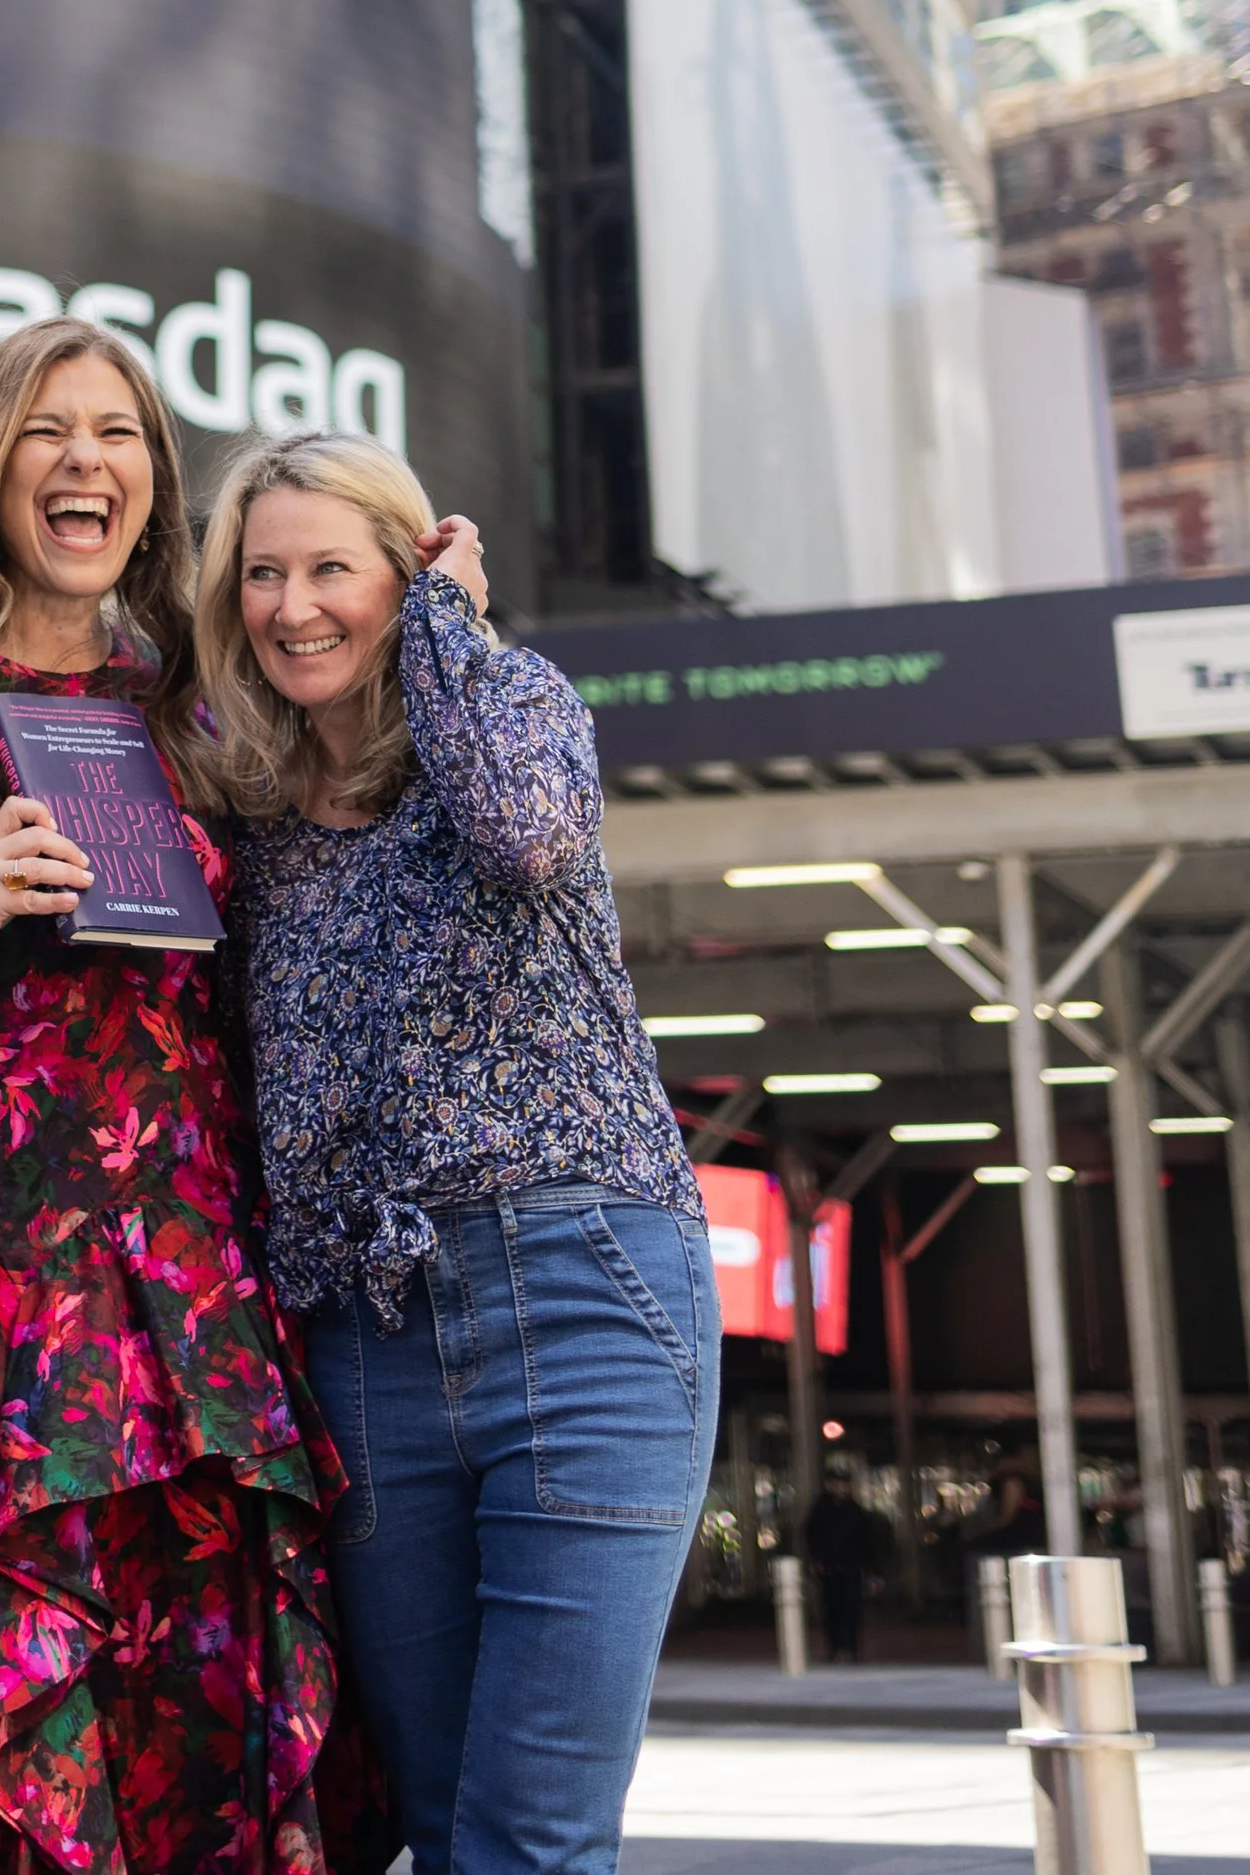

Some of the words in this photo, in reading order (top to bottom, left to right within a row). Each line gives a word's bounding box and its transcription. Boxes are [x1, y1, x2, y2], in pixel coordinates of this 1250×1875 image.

[21, 732, 47, 741] Women
[47, 734, 94, 744] Entrepreneurs
[69, 760, 124, 795] THE
[88, 847, 167, 898] WAY
[106, 902, 142, 913] CARRIE
[142, 905, 180, 916] KERPEN
